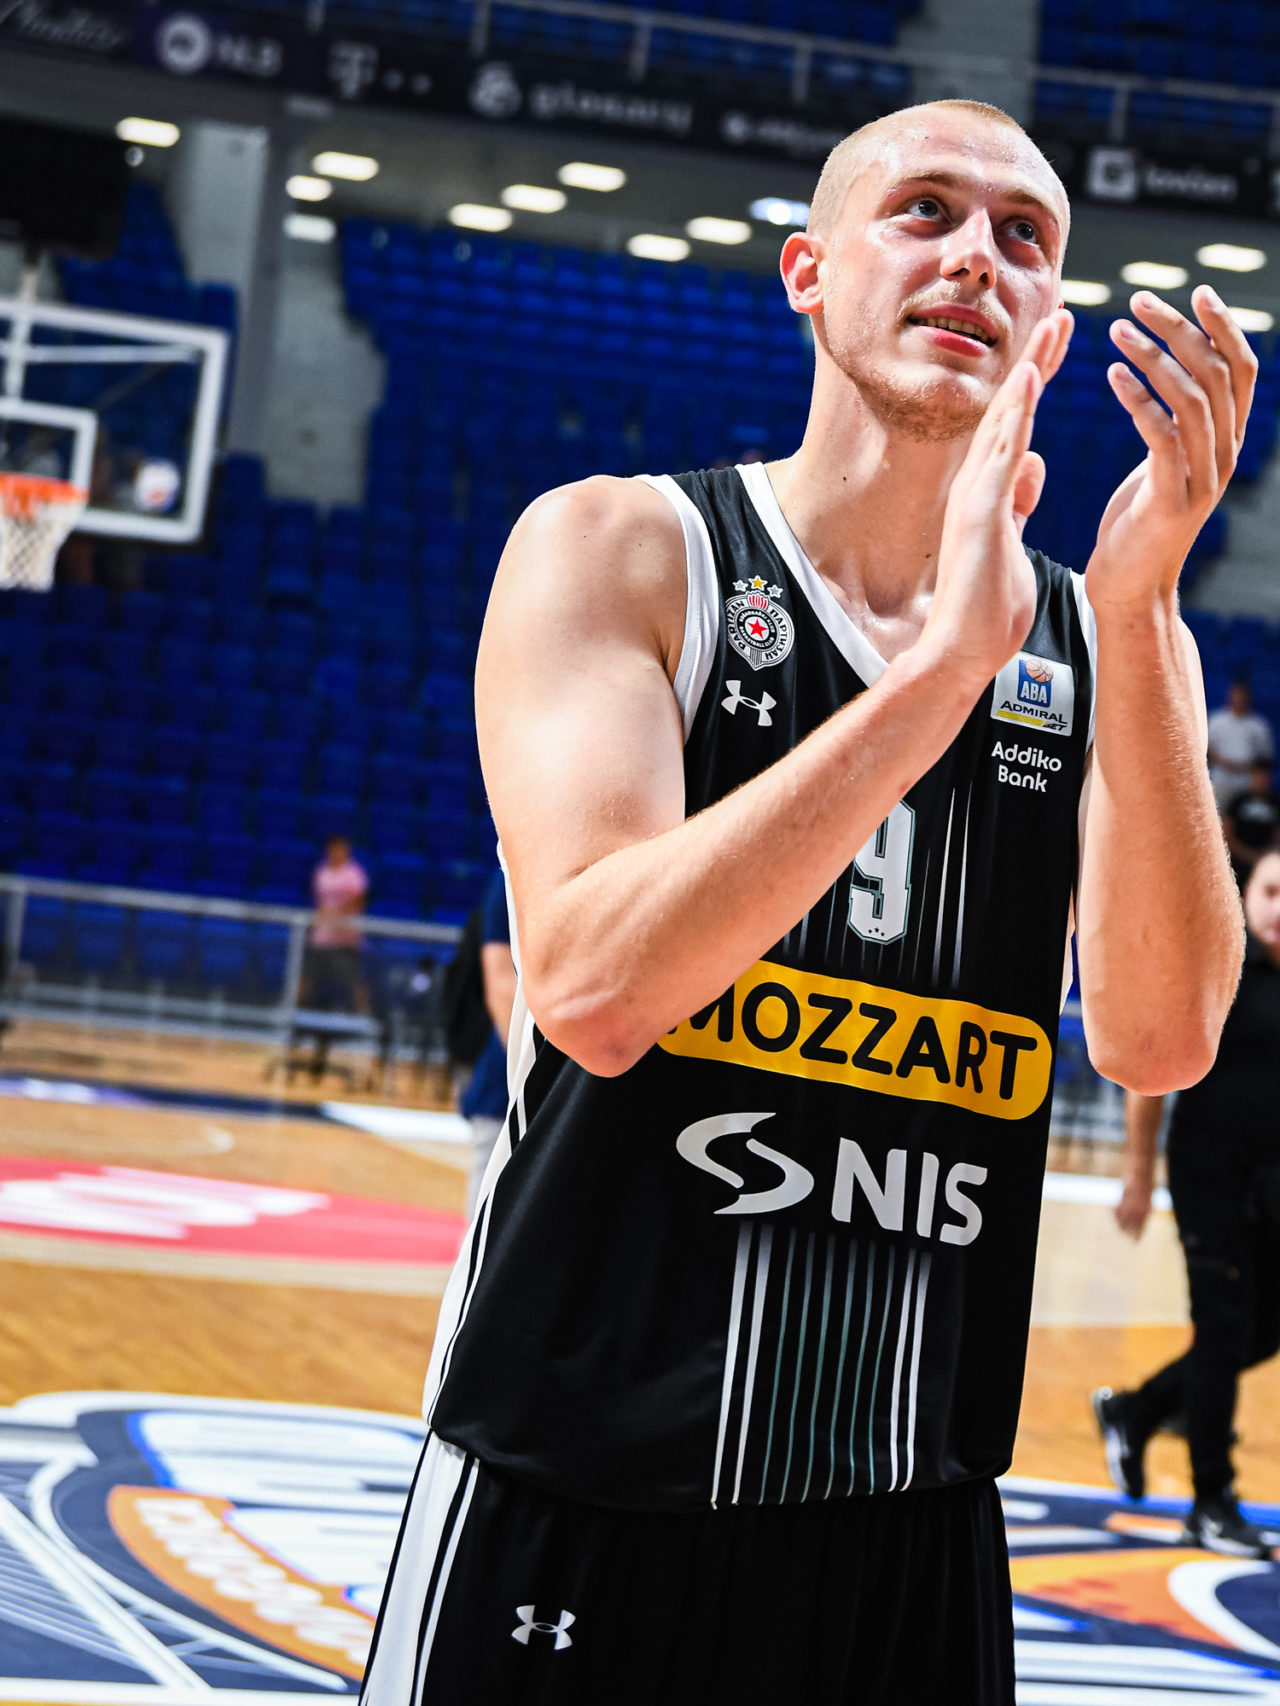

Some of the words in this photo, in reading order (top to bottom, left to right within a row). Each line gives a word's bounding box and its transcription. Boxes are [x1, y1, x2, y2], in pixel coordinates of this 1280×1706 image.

[765, 609, 788, 660] ПАРТИЗАН
[1020, 680, 1048, 704] ABA
[1000, 700, 1068, 725] ADMIRAL
[991, 741, 1062, 772] Addiko
[997, 764, 1048, 793] Bank
[847, 799, 916, 945] 9
[830, 1136, 988, 1246] NIS
